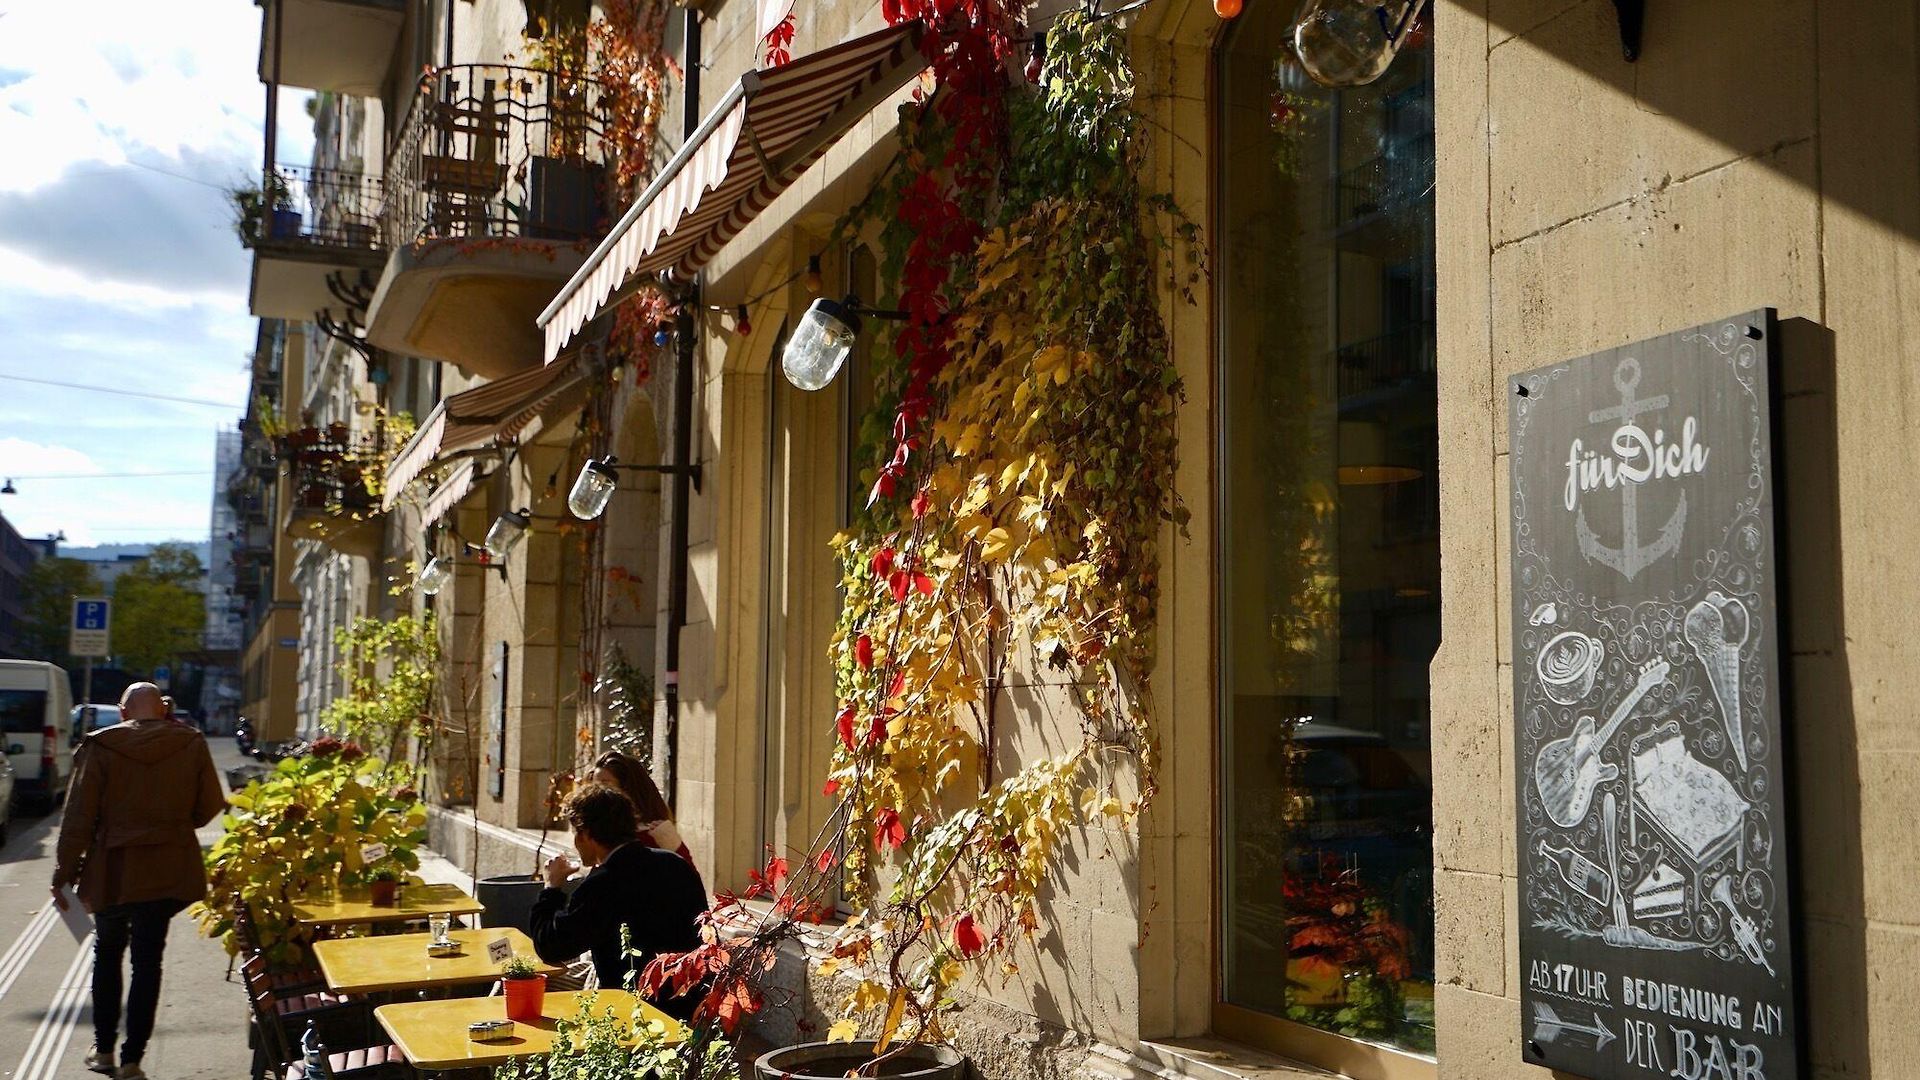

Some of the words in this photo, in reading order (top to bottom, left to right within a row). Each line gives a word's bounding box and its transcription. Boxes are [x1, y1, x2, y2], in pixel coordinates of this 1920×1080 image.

[86, 603, 98, 616] P
[1529, 959, 1551, 989] AB
[1553, 963, 1575, 993] 17
[1575, 967, 1610, 1001] UHR
[1622, 976, 1742, 1030] BEDIENUNG
[1752, 1001, 1782, 1036] AN
[1624, 1017, 1664, 1072] DER
[1669, 1023, 1767, 1080] BAR
